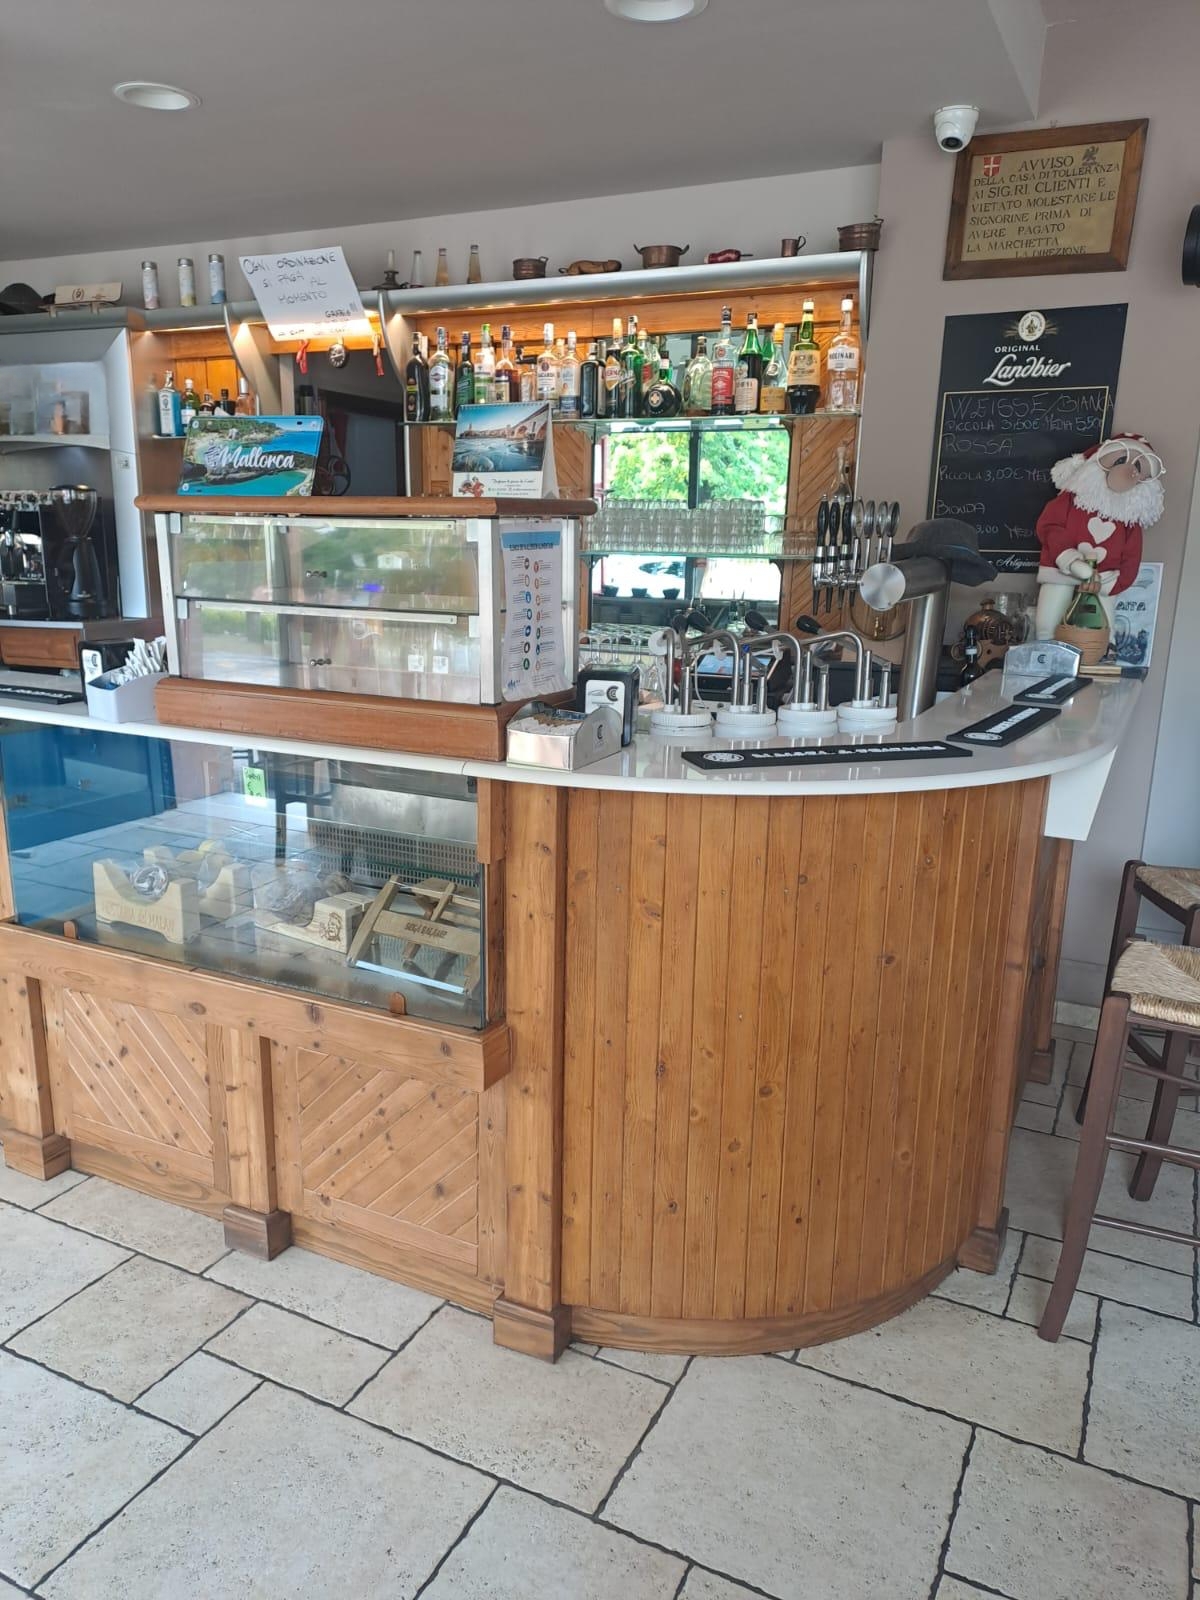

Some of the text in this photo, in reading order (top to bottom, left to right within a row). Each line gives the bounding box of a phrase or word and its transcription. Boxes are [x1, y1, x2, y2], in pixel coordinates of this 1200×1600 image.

[1018, 156, 1075, 172] AVVISO
[974, 163, 1120, 187] DELLA CASA DI TOLLERANZA
[1035, 178, 1090, 193] CLIENTI
[1098, 177, 1106, 187] E
[970, 190, 1116, 213] VIETATO MOLESTARE LE
[969, 207, 1092, 226] SIGNORINE PRIMA DI
[968, 222, 1065, 240] AVERE PAGATO
[967, 237, 1059, 253] LA MARCHETTA
[1015, 244, 1087, 258] LA DIREZIONE
[994, 344, 1041, 354] ORIGINAL
[982, 353, 1072, 387] Landbier
[943, 432, 1013, 455] ROSSA
[218, 446, 296, 469] Mallorca
